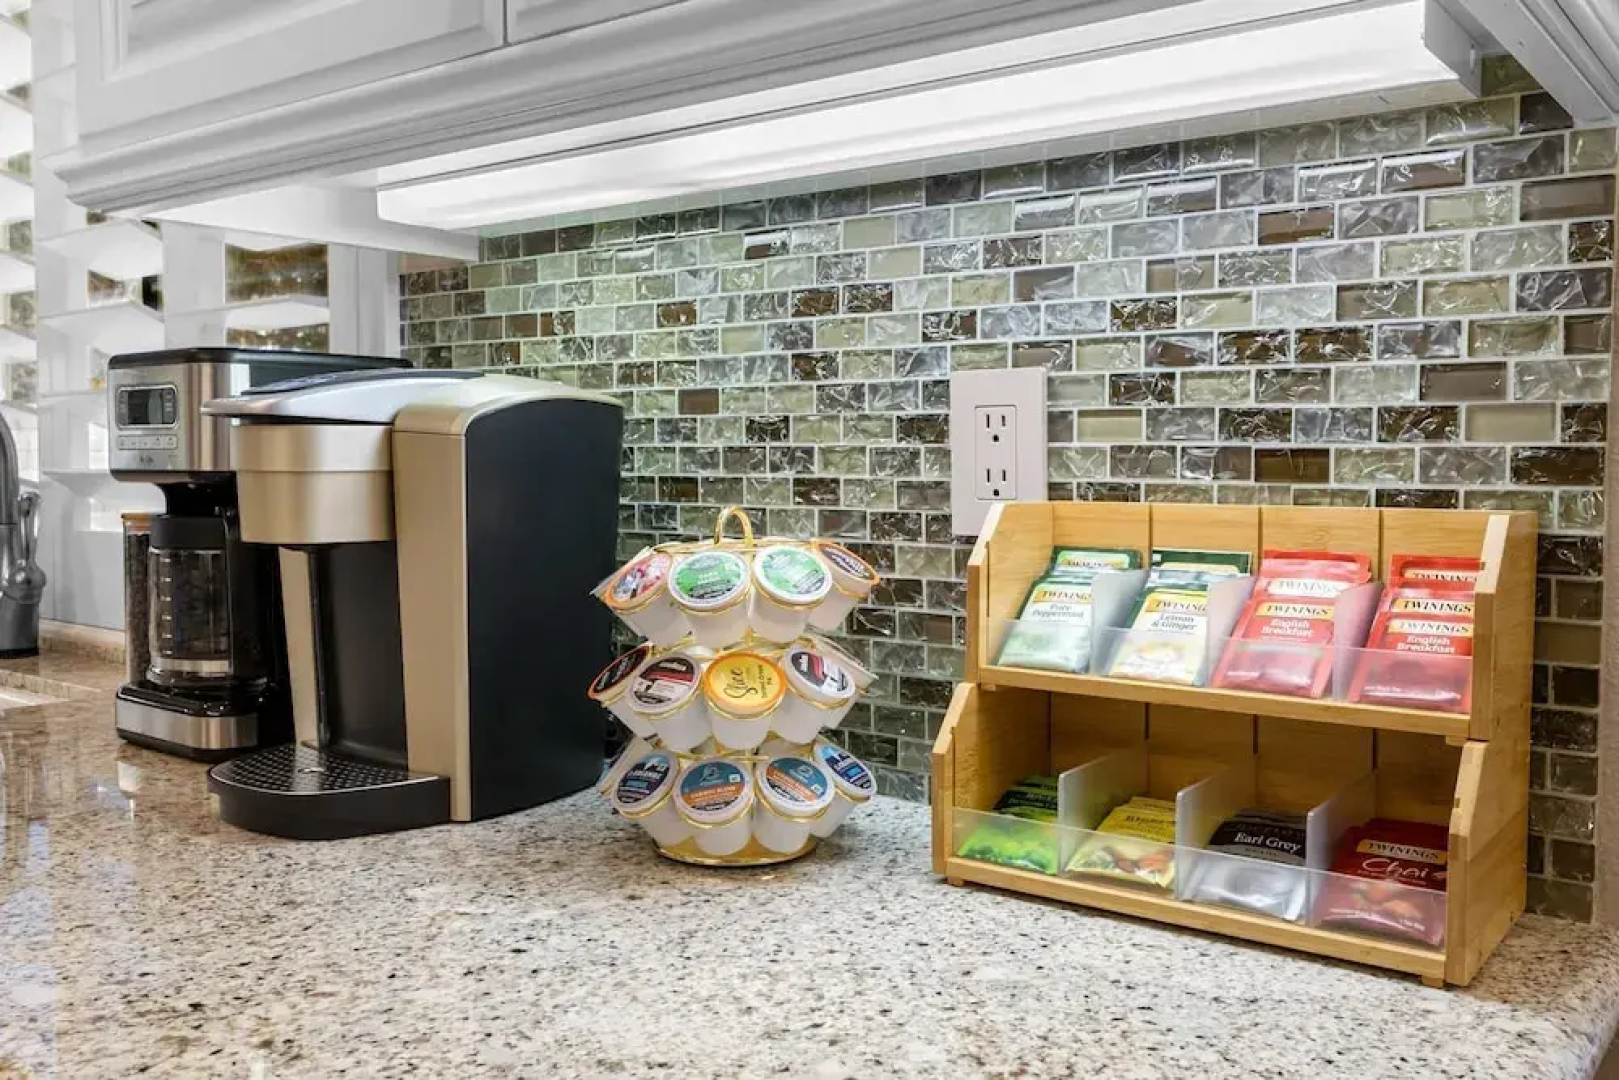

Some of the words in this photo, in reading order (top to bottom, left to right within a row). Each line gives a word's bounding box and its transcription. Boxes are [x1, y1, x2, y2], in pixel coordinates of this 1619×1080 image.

[1266, 604, 1332, 616] TWININGS
[1403, 599, 1472, 613] TWININGS
[1269, 618, 1310, 629] English
[1399, 621, 1469, 634] TWININGS
[1260, 625, 1315, 636] Breakfast
[1406, 634, 1451, 645] English
[1396, 642, 1456, 654] Breakfast
[1234, 831, 1264, 845] Earl
[1265, 836, 1301, 853] Grey
[1368, 842, 1438, 859] TWININGS
[1362, 857, 1429, 880] Chai
